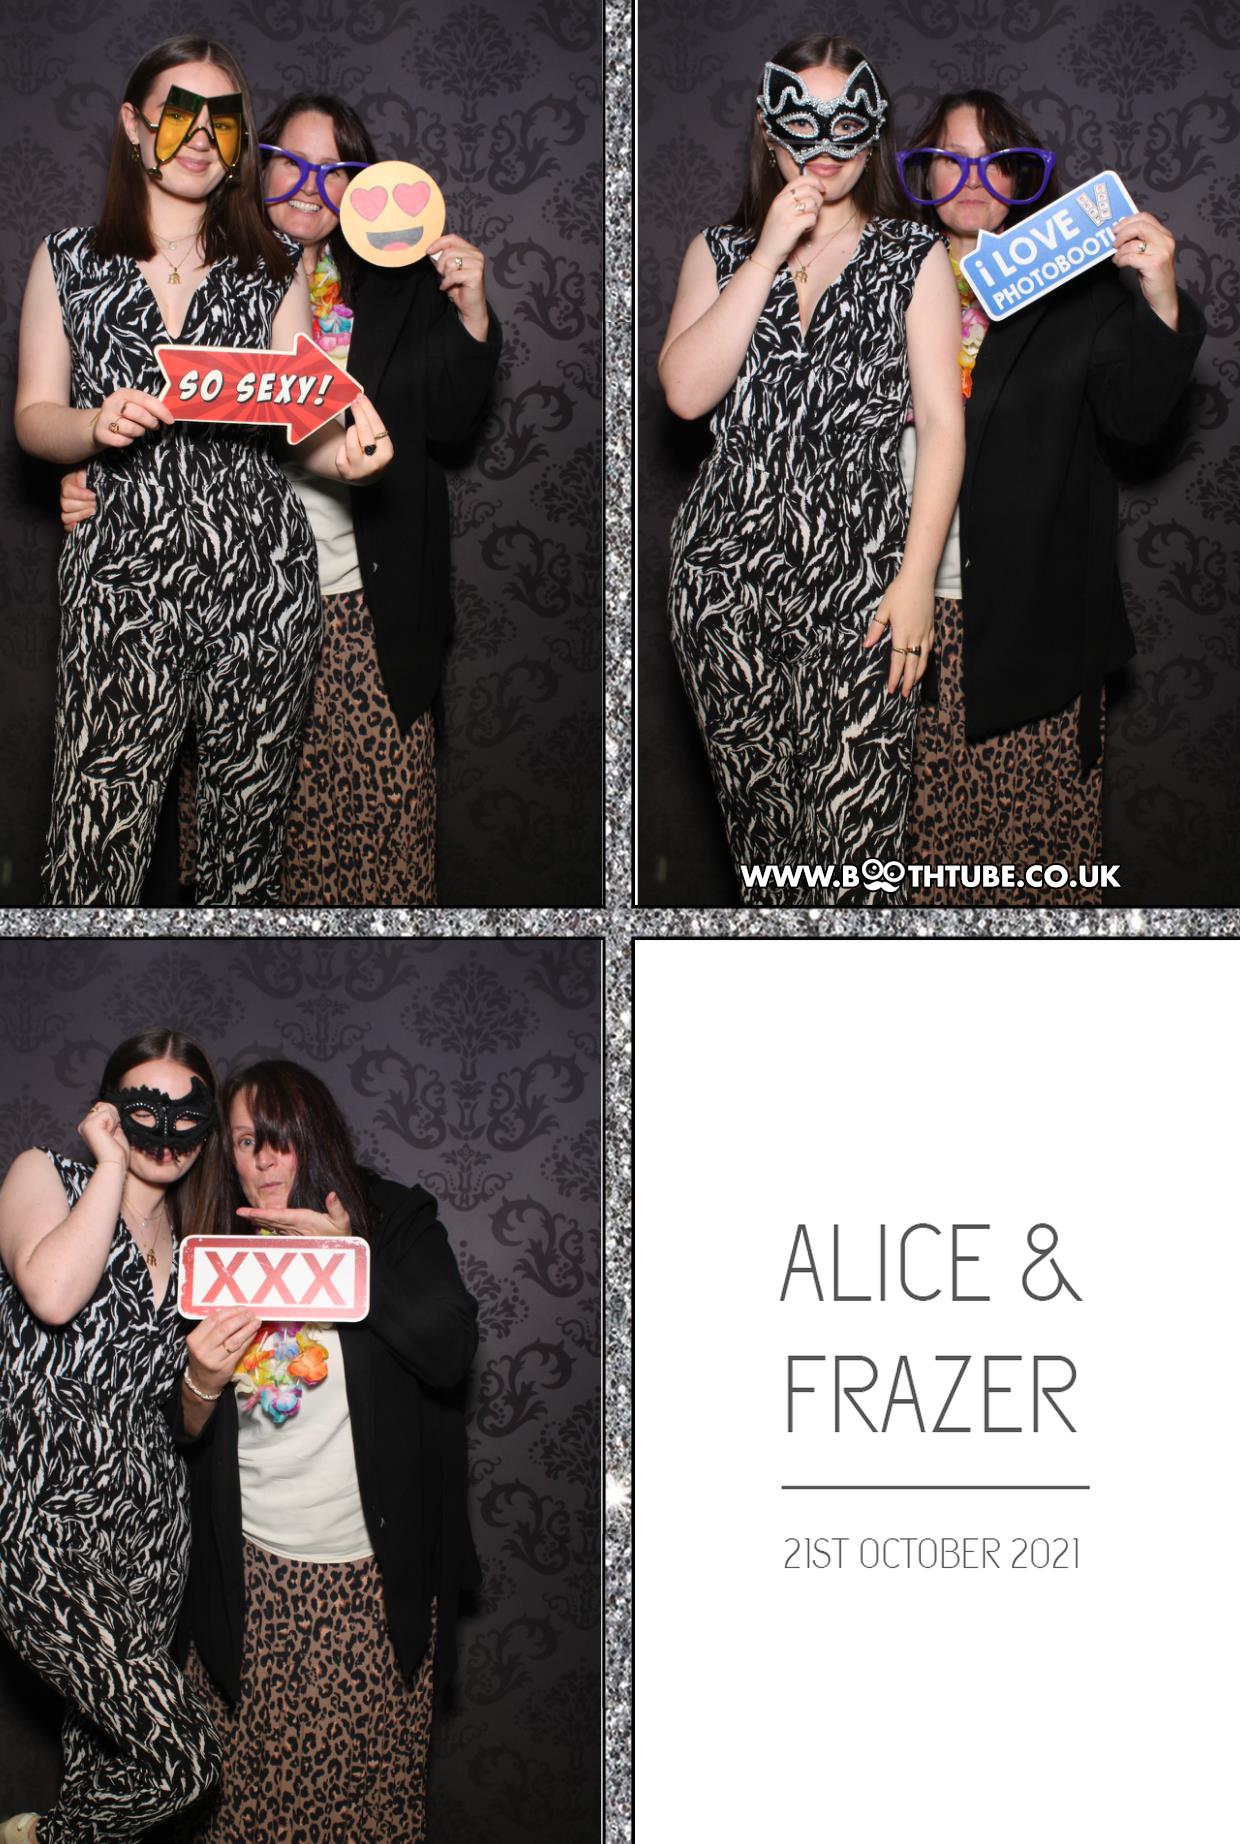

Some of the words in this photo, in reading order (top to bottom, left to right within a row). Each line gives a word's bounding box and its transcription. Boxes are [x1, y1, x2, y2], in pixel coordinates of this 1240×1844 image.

[975, 260, 996, 288] i
[992, 208, 1081, 278] LOVE
[992, 216, 1126, 311] PHOTOBOOT
[179, 369, 224, 402] SO
[236, 372, 334, 406] SEXY!
[201, 1251, 347, 1305] XXX
